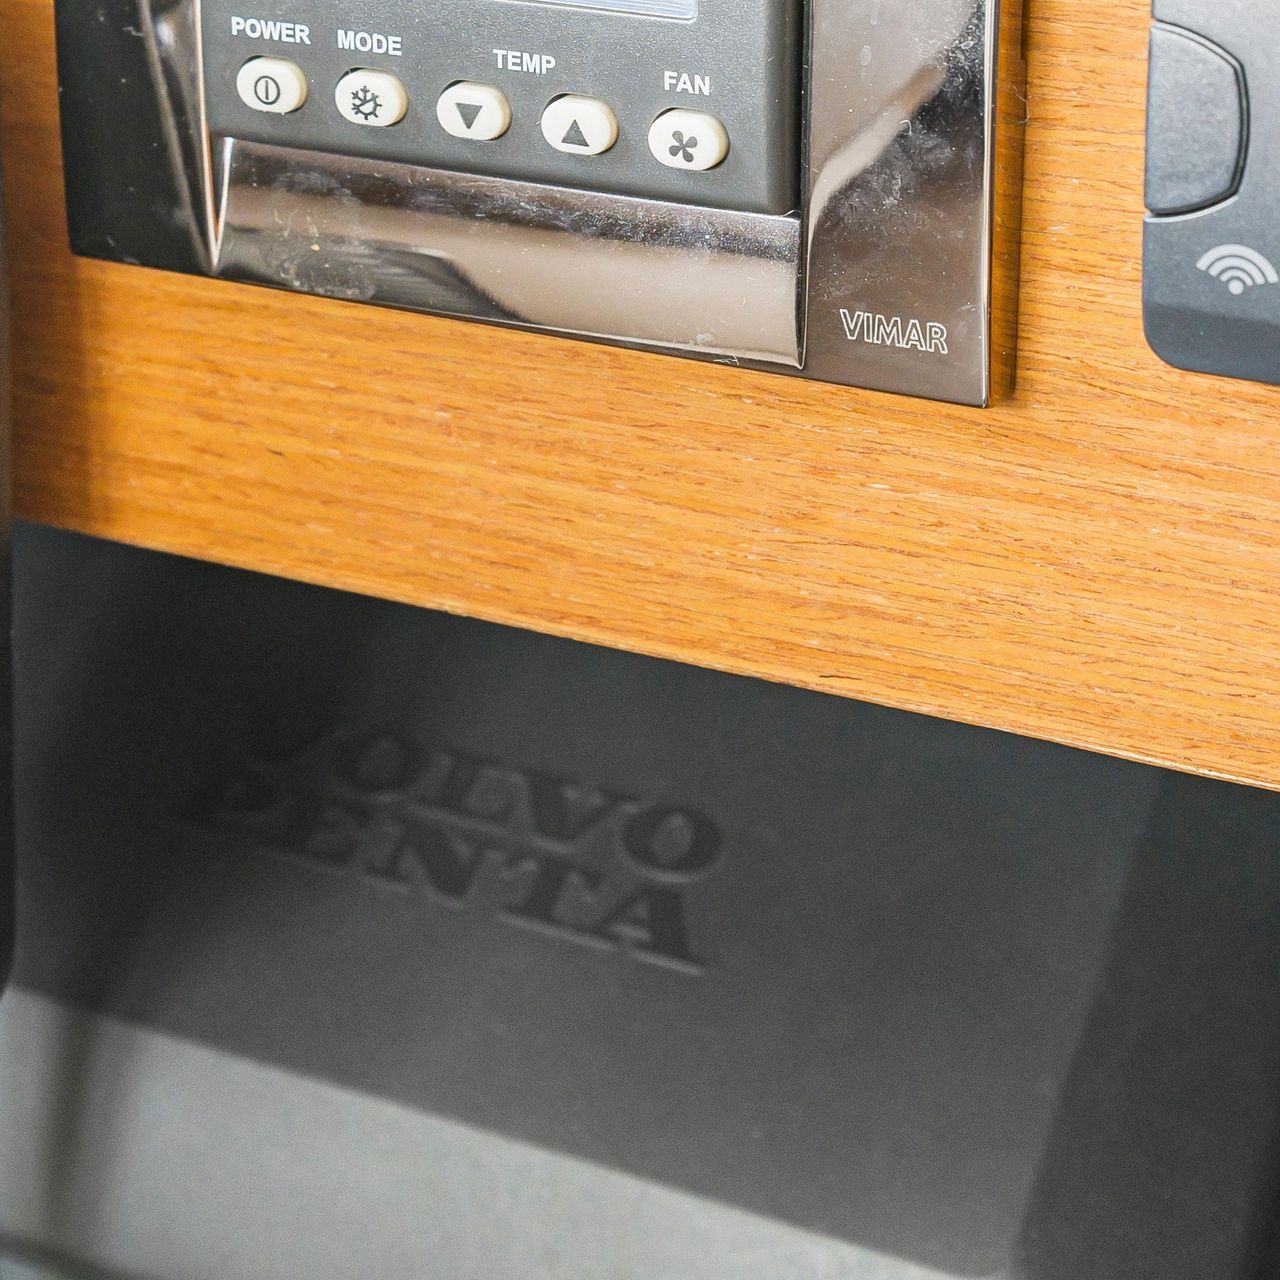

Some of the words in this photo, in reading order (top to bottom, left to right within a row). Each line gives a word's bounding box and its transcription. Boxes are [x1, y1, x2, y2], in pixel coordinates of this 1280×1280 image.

[231, 16, 311, 45] POWER
[336, 29, 403, 57] MODE
[493, 48, 556, 75] TEMP
[663, 71, 711, 96] FAN
[839, 308, 949, 355] VIMAR
